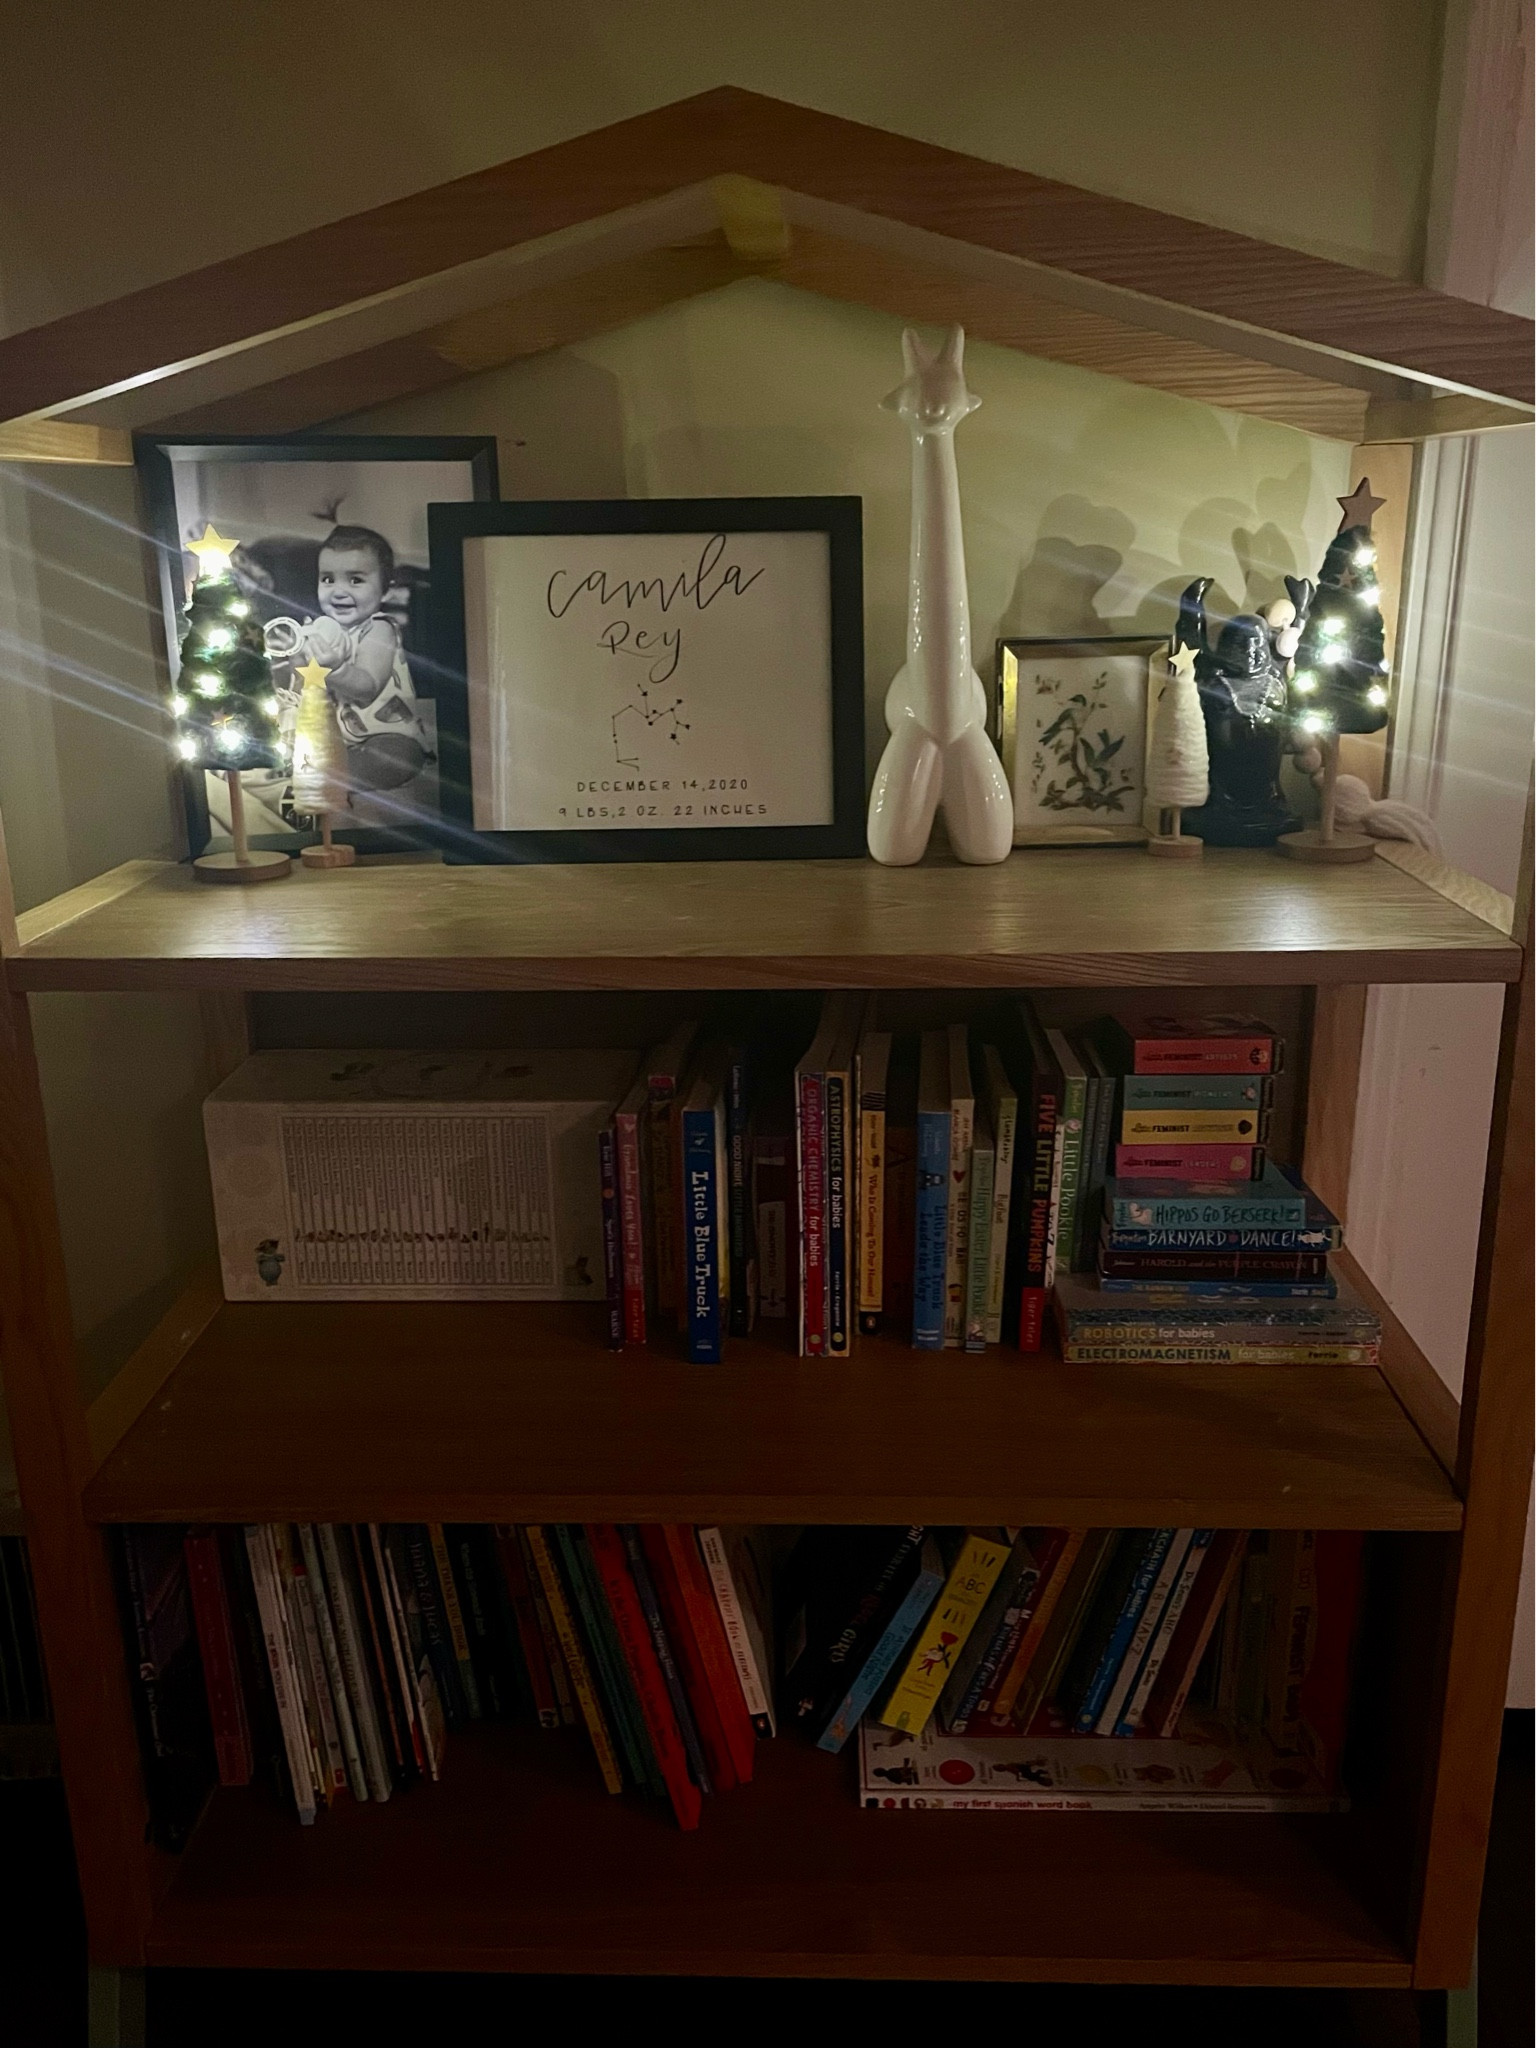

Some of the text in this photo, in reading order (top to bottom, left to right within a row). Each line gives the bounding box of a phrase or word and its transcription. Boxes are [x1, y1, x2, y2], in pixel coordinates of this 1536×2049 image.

[597, 620, 681, 684] Rey
[577, 778, 749, 792] DECEMBER 14,2020
[558, 807, 567, 816] 9
[674, 805, 694, 816] 22
[704, 804, 767, 815] INCHES
[1037, 1094, 1057, 1133] FIVE
[733, 1135, 741, 1158] GOOD
[828, 1084, 843, 1228] ASTROPHYSICS for babies
[805, 1088, 820, 1267] ORGANIC CHEMISTRY for babies
[1032, 1139, 1053, 1192] LITTLE
[867, 1174, 878, 1193] Who
[867, 1195, 877, 1204] Is
[1056, 1138, 1080, 1240] Little Pookie
[971, 1187, 990, 1220] Happy
[1155, 1203, 1284, 1226] HIPPOS GO BERSERK!
[865, 1206, 878, 1237] Coming
[1026, 1198, 1048, 1272] PUMPKINS
[1147, 1227, 1226, 1248] BARNYARD
[1240, 1228, 1296, 1247] DANCE!
[691, 1170, 710, 1318] Little Blue Truck
[867, 1239, 877, 1250] To
[867, 1251, 876, 1267] Our
[915, 1213, 931, 1302] Leads the Way
[932, 1205, 946, 1309] Little Blue Truck
[973, 1256, 988, 1283] Little
[1140, 1258, 1186, 1268] HAROLD
[1024, 1295, 1037, 1343] tiger tales
[1082, 1326, 1215, 1341] ROBOTICS for babies
[1077, 1343, 1231, 1364] ELECTROMAGNETISM
[1237, 1347, 1255, 1359] for
[1257, 1348, 1295, 1360] babies
[441, 1566, 454, 1601] THANK
[448, 1602, 458, 1621] YOU
[954, 1573, 987, 1596] ABC
[1125, 1571, 1151, 1620] for babies
[823, 1624, 859, 1667] GIRLS
[1288, 1605, 1309, 1678] FEMINIST
[971, 1799, 990, 1807] first
[994, 1800, 1033, 1809] spanish
